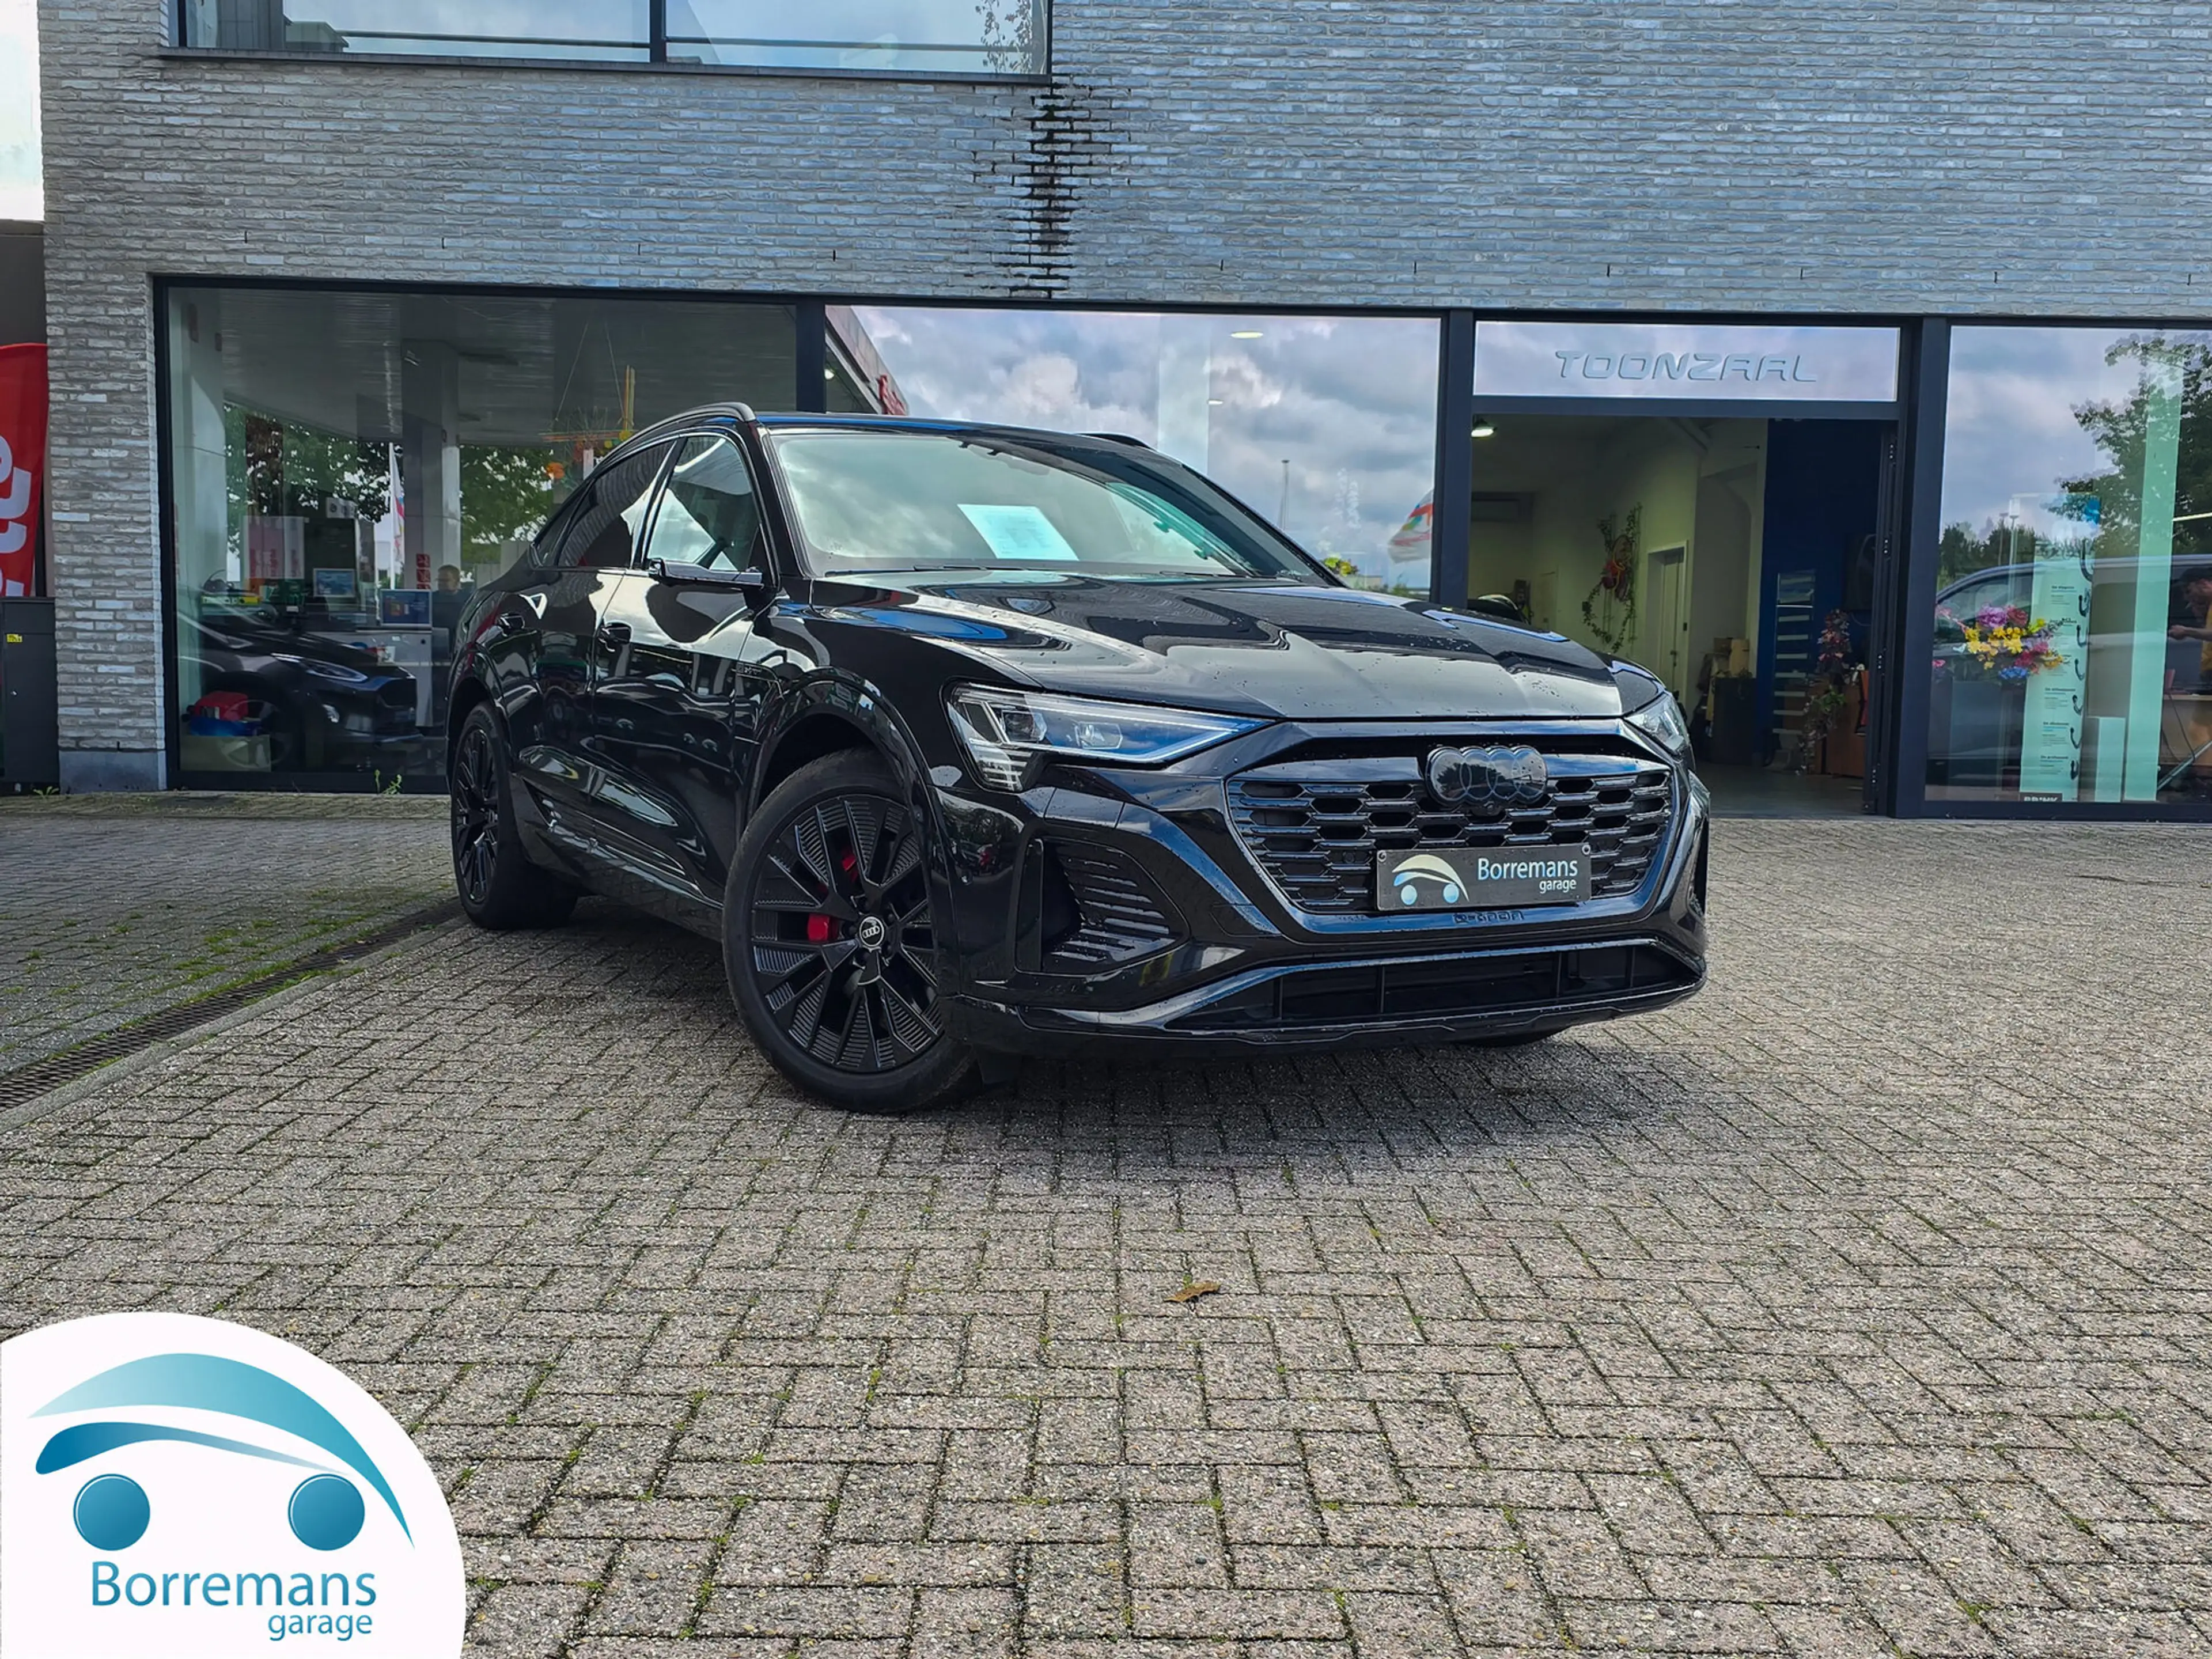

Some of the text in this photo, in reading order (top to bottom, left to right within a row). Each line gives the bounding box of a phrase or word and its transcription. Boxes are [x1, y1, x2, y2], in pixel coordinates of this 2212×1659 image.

[1555, 350, 1816, 382] TOONZAAL
[1478, 858, 1578, 880] Borremans
[1539, 880, 1577, 894] garage
